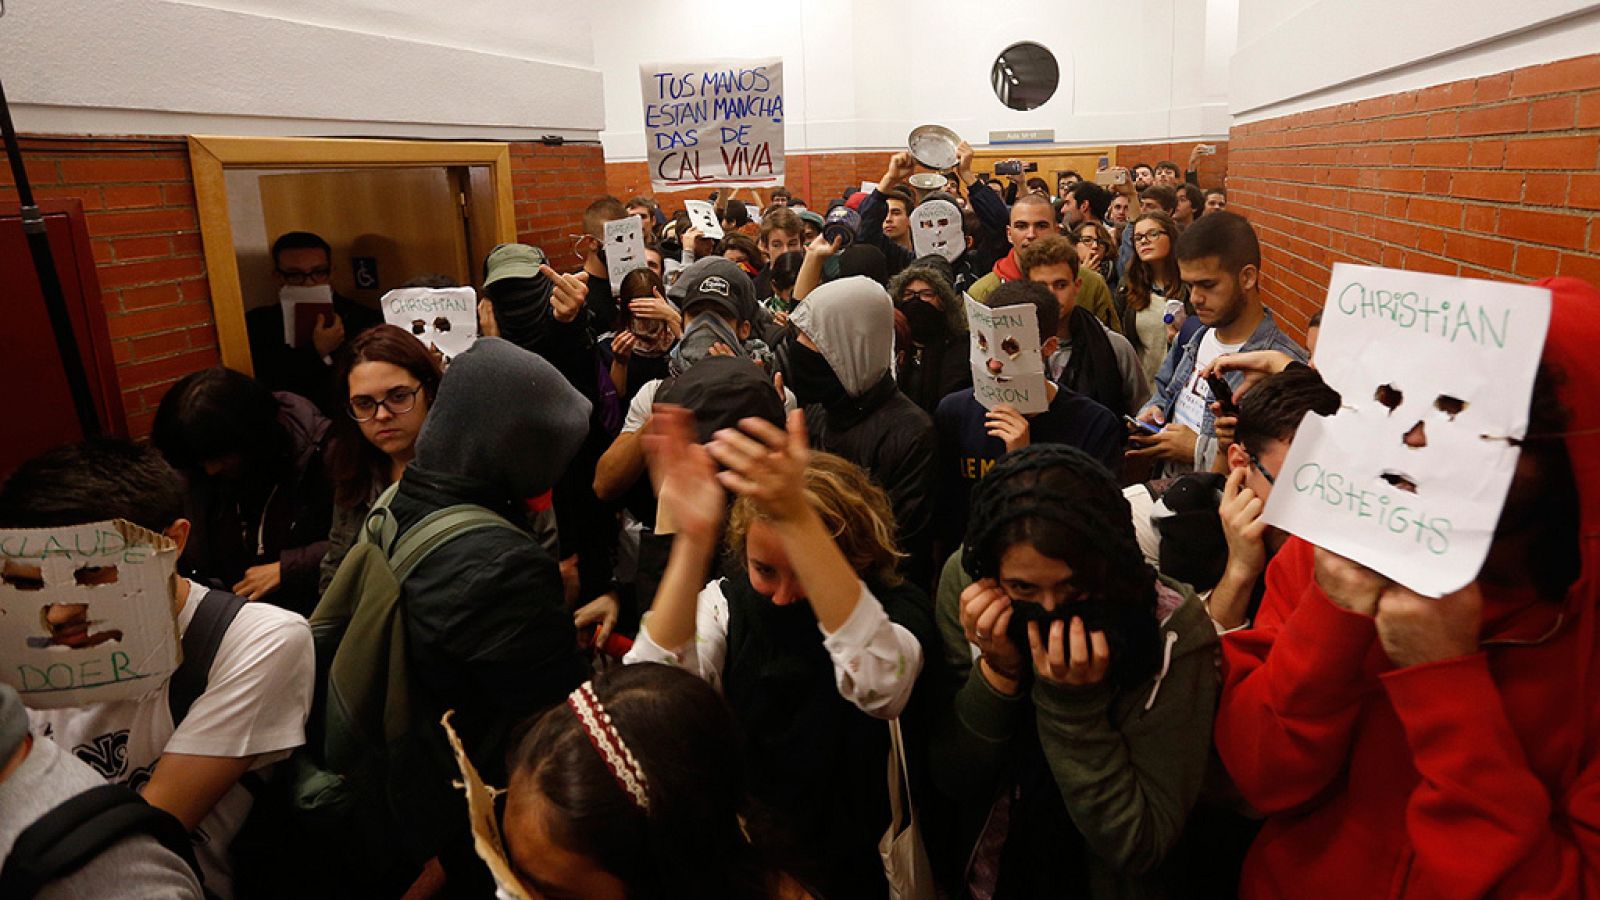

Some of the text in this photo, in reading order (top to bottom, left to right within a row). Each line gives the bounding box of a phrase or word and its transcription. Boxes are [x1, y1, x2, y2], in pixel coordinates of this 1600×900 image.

[654, 66, 770, 99] TUS MANOS
[646, 95, 784, 128] ESTAN MANCHA
[655, 125, 752, 150] DAS DE
[658, 142, 773, 181] CAL VIVA
[18, 651, 141, 691] DOER
